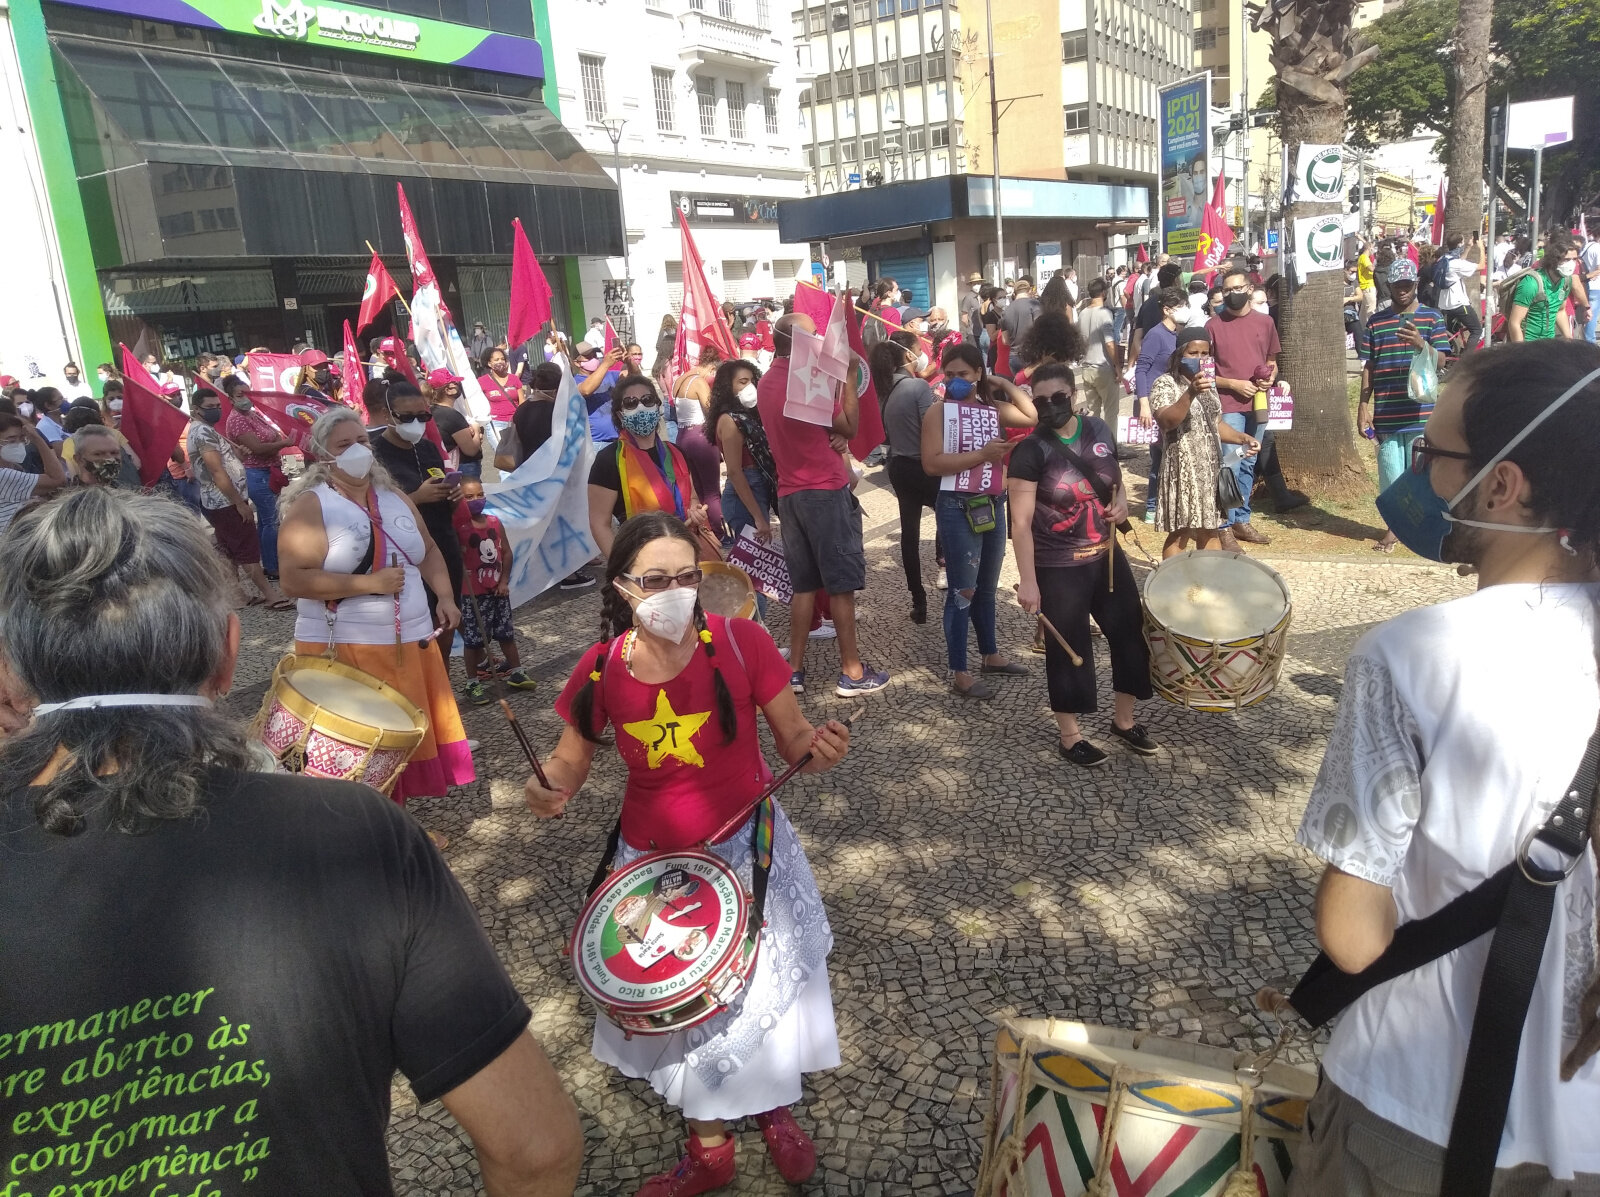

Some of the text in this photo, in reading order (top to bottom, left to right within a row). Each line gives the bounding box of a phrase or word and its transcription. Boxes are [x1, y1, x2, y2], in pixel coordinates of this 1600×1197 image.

[317, 6, 420, 42] MICROCAMP
[1168, 91, 1200, 118] IPTU
[1168, 111, 1200, 137] 2021
[961, 406, 971, 415] E
[754, 560, 791, 584] OURÃO
[763, 582, 792, 603] FORA
[665, 862, 714, 876] Fund. 1916
[588, 867, 654, 935] Baque das Ondas
[714, 875, 733, 905] Nação
[725, 907, 736, 922] do
[586, 941, 597, 962] 1916
[689, 927, 733, 979] Maracatu
[618, 986, 646, 998] Rico
[650, 976, 687, 995] Porto
[0, 1016, 251, 1097] re aberto às
[12, 1054, 271, 1136] experiências,
[11, 1099, 259, 1176] conformar a
[48, 1131, 270, 1197] experiência
